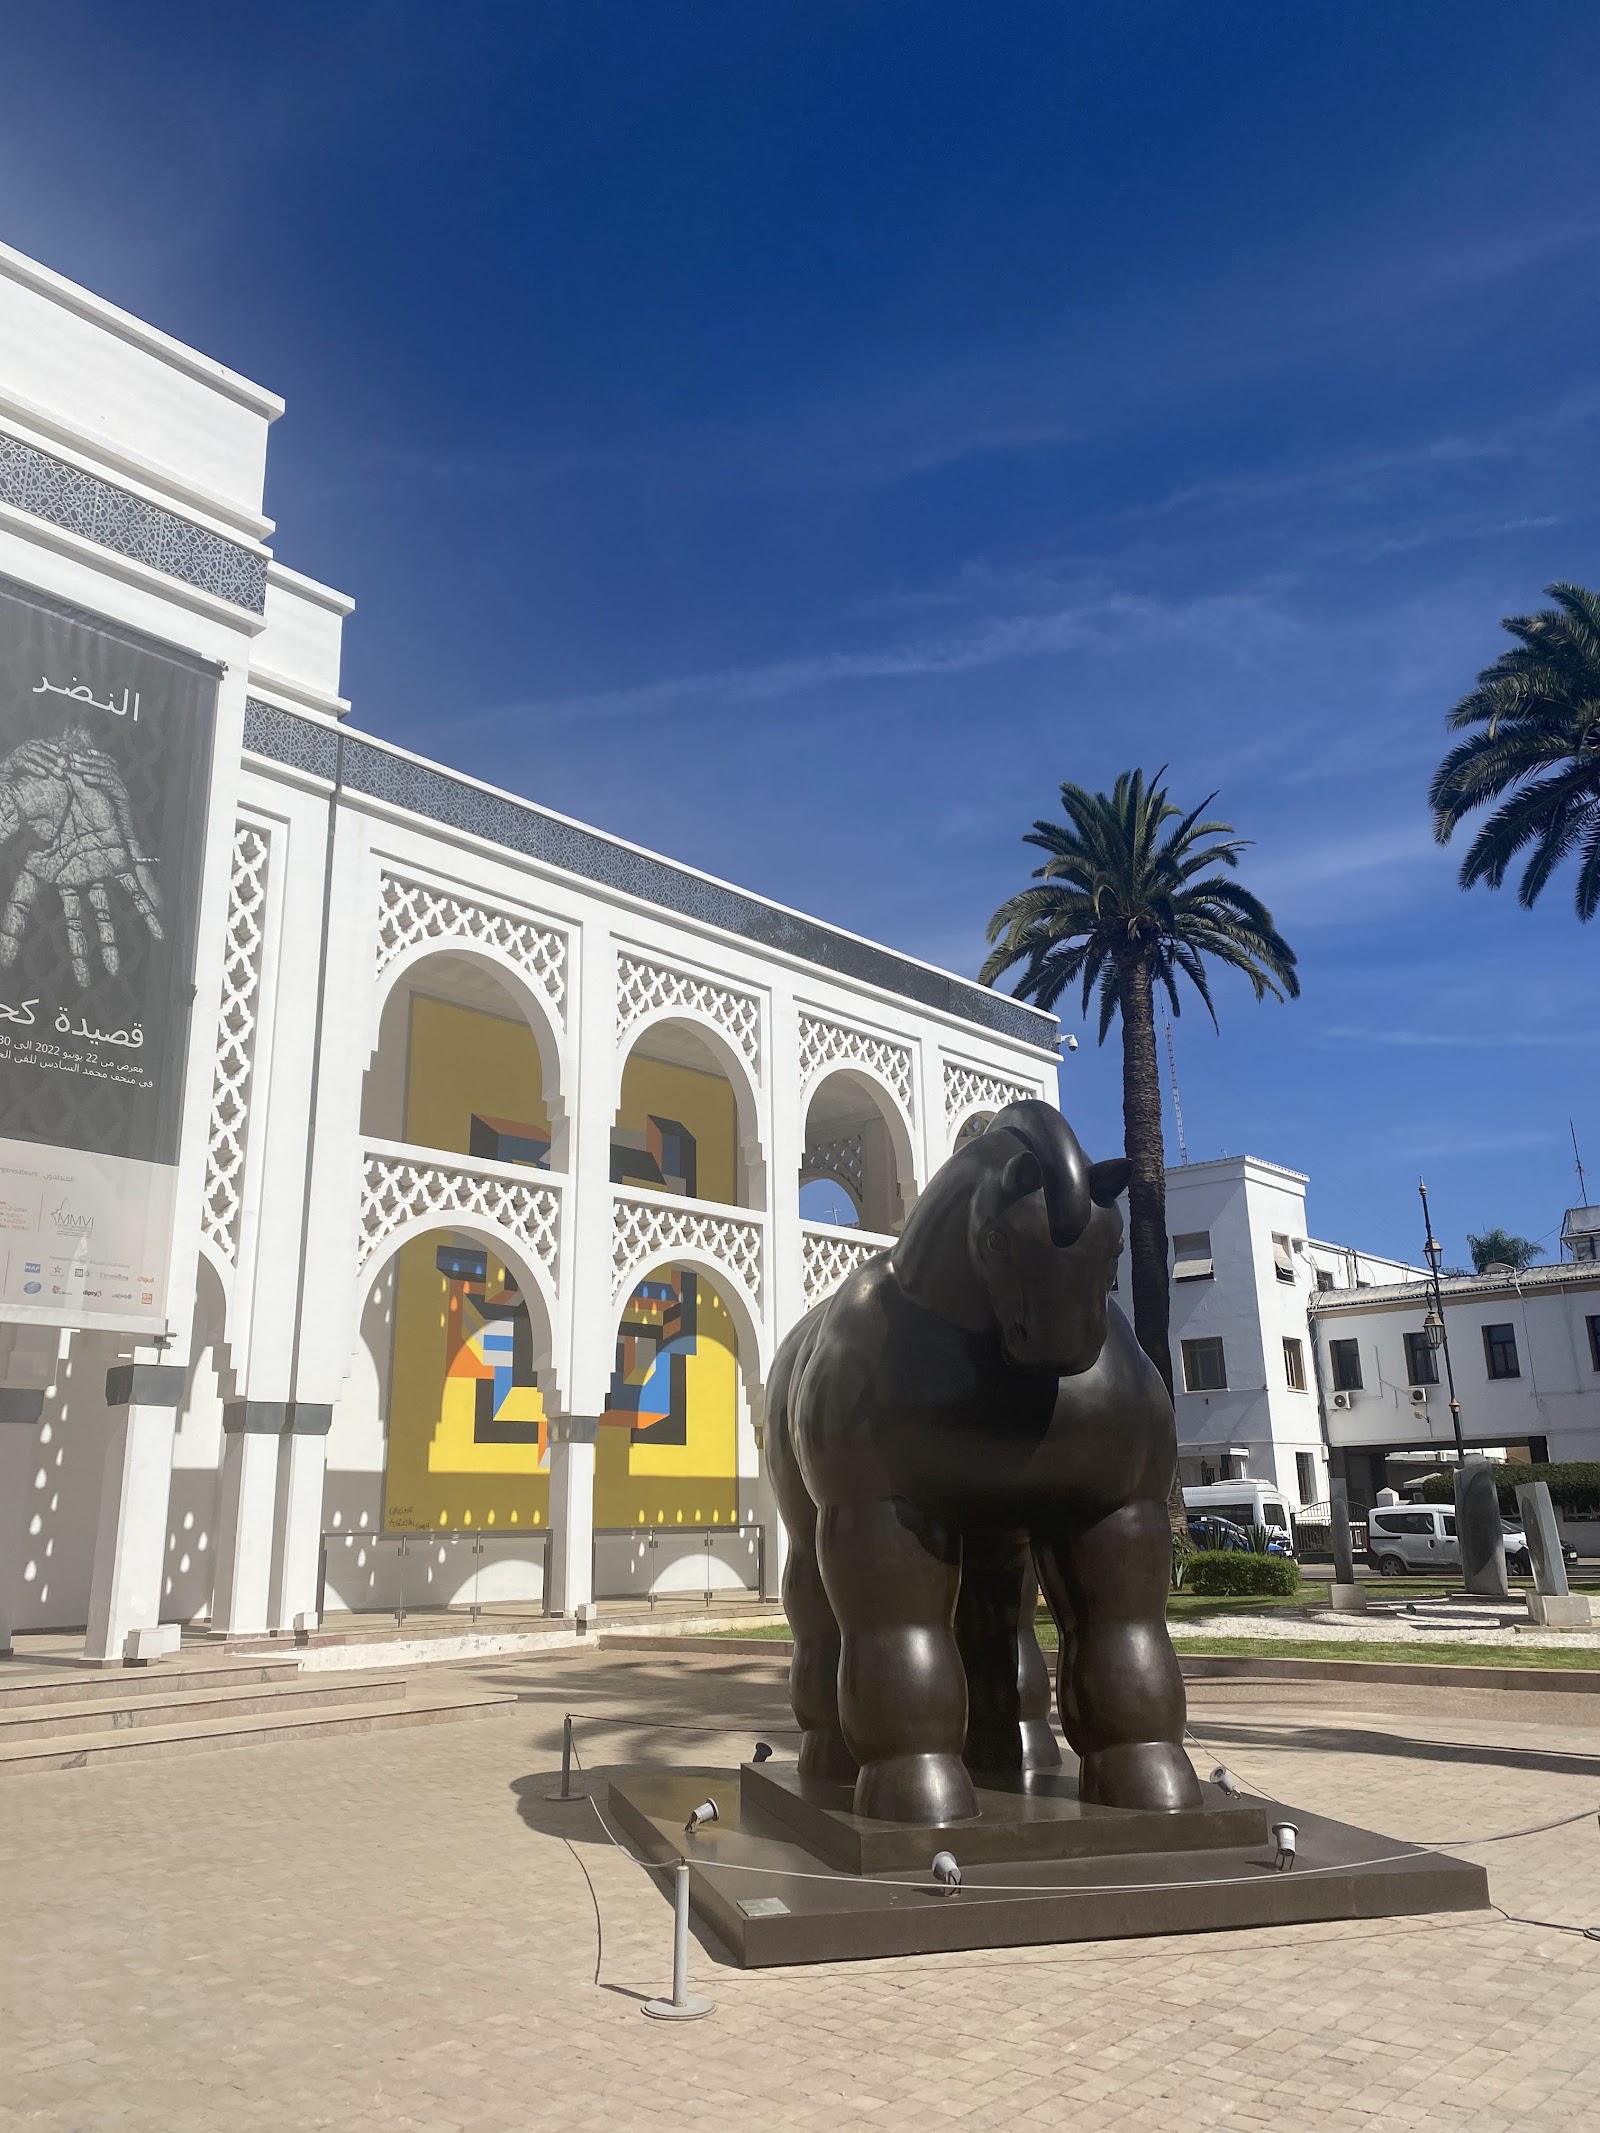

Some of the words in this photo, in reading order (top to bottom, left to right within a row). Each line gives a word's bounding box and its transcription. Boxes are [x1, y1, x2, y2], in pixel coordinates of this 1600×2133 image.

[32, 676, 140, 722] النضر
[0, 998, 40, 1025] كح
[54, 1006, 144, 1049] قصيدة
[35, 1042, 61, 1056] 2022
[14, 1054, 37, 1065] للفن
[85, 1052, 98, 1064] 22
[100, 1059, 115, 1068] من
[39, 1060, 80, 1074] السادس
[82, 1066, 108, 1079] محمد
[116, 1062, 144, 1074] معرض
[110, 1073, 136, 1086] متحف
[138, 1079, 154, 1089] في
[57, 1212, 95, 1228] MMVI
